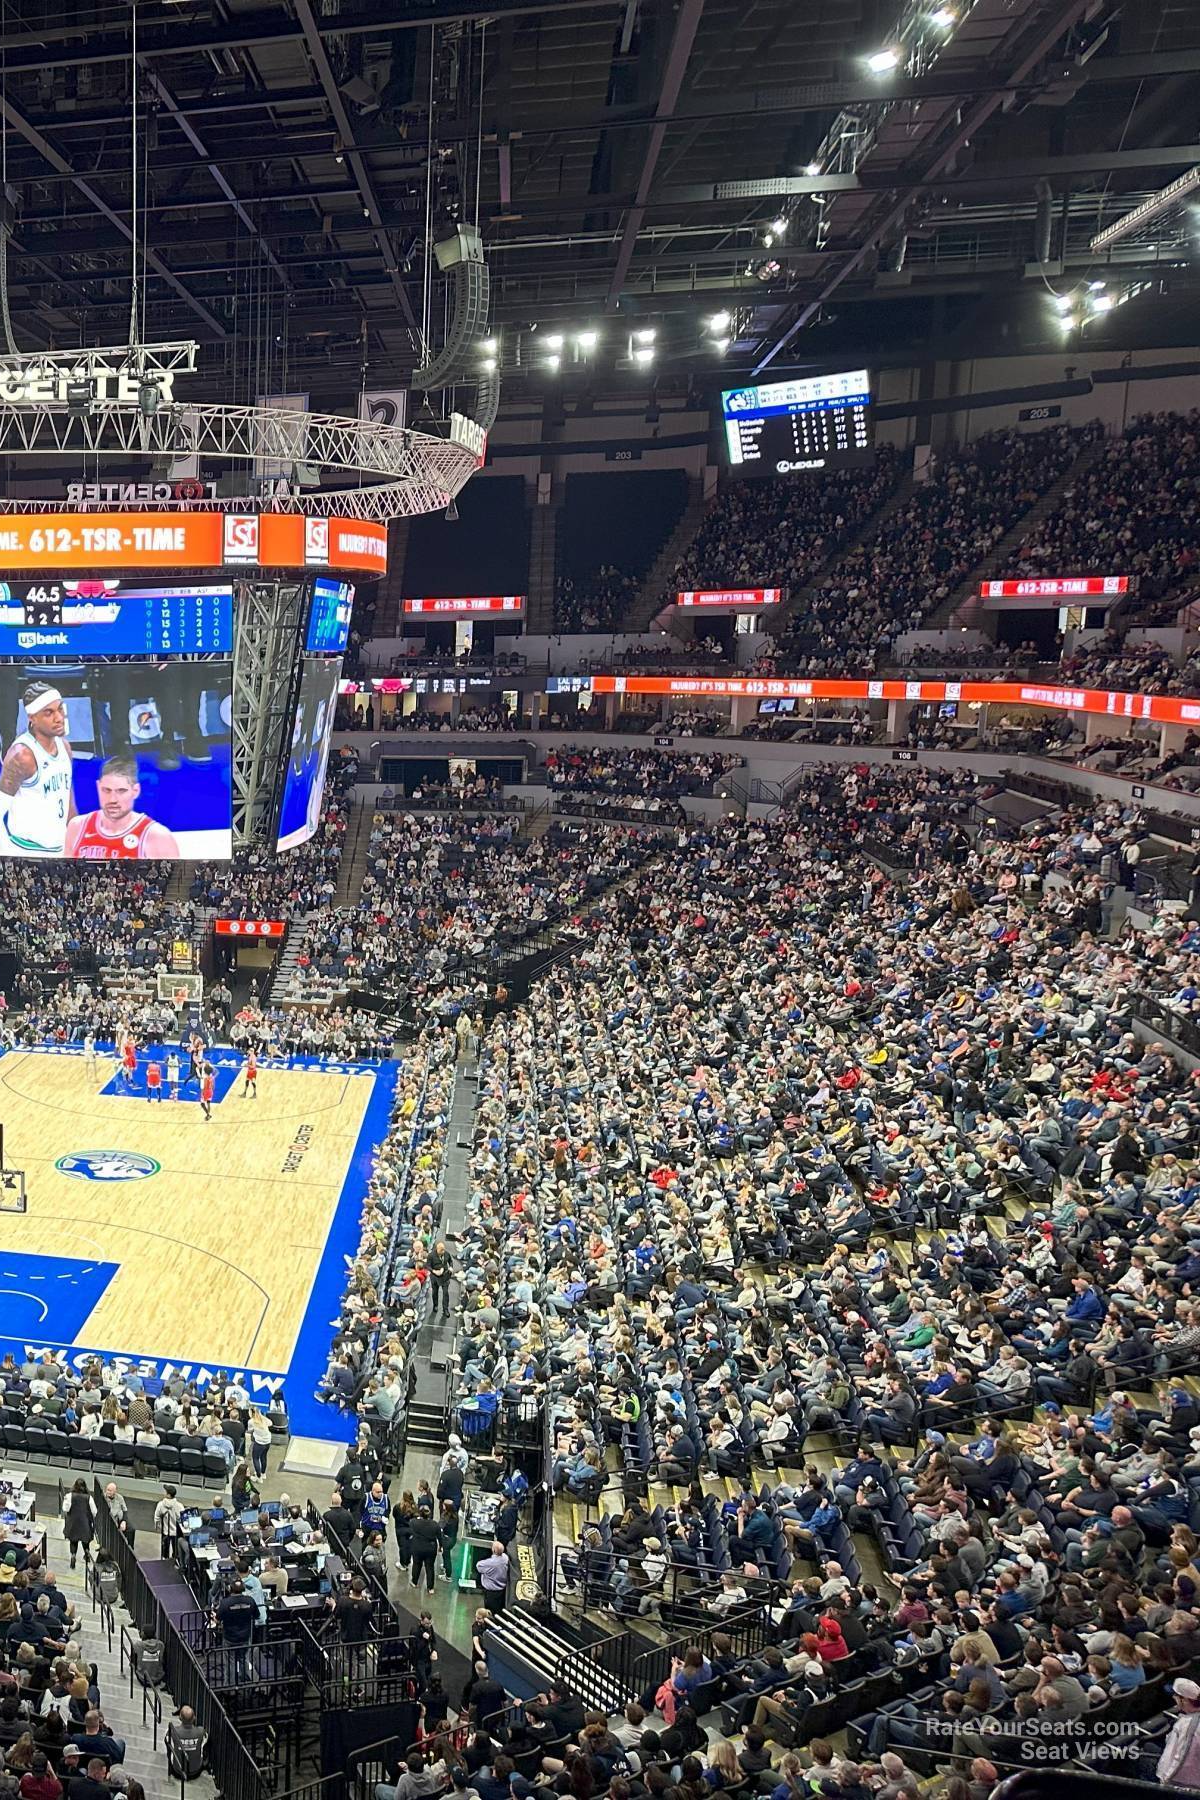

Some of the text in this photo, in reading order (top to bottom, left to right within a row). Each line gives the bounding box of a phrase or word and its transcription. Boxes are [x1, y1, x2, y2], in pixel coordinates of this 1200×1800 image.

[1030, 408, 1050, 419] 205
[615, 451, 632, 460] 203
[789, 459, 825, 470] LEXUS
[29, 527, 186, 552] 612-TSR-TIME
[1016, 580, 1089, 594] 612-TSR-TIME
[26, 587, 60, 603] 46.5
[162, 599, 169, 607] 3
[180, 598, 185, 607] 3
[196, 598, 202, 606] 0
[213, 597, 220, 606] 0
[434, 599, 490, 610] 612-TSR-TIME
[146, 607, 220, 618] 9 12 2 3 0
[27, 615, 34, 624] 6
[39, 614, 48, 625] 2
[53, 615, 60, 624] 4
[162, 619, 170, 627] 15
[180, 619, 185, 627] 3
[196, 618, 202, 627] 2
[213, 618, 220, 626] 2
[162, 630, 169, 638] 6
[196, 629, 202, 637] 3
[213, 628, 220, 636] 0
[196, 639, 202, 647] 4
[213, 638, 220, 647] 0
[671, 681, 700, 691] INJURED?
[746, 682, 813, 695] 612-TSR-TIME
[57, 798, 65, 818] 3
[281, 1124, 314, 1173] TARGET CENTER
